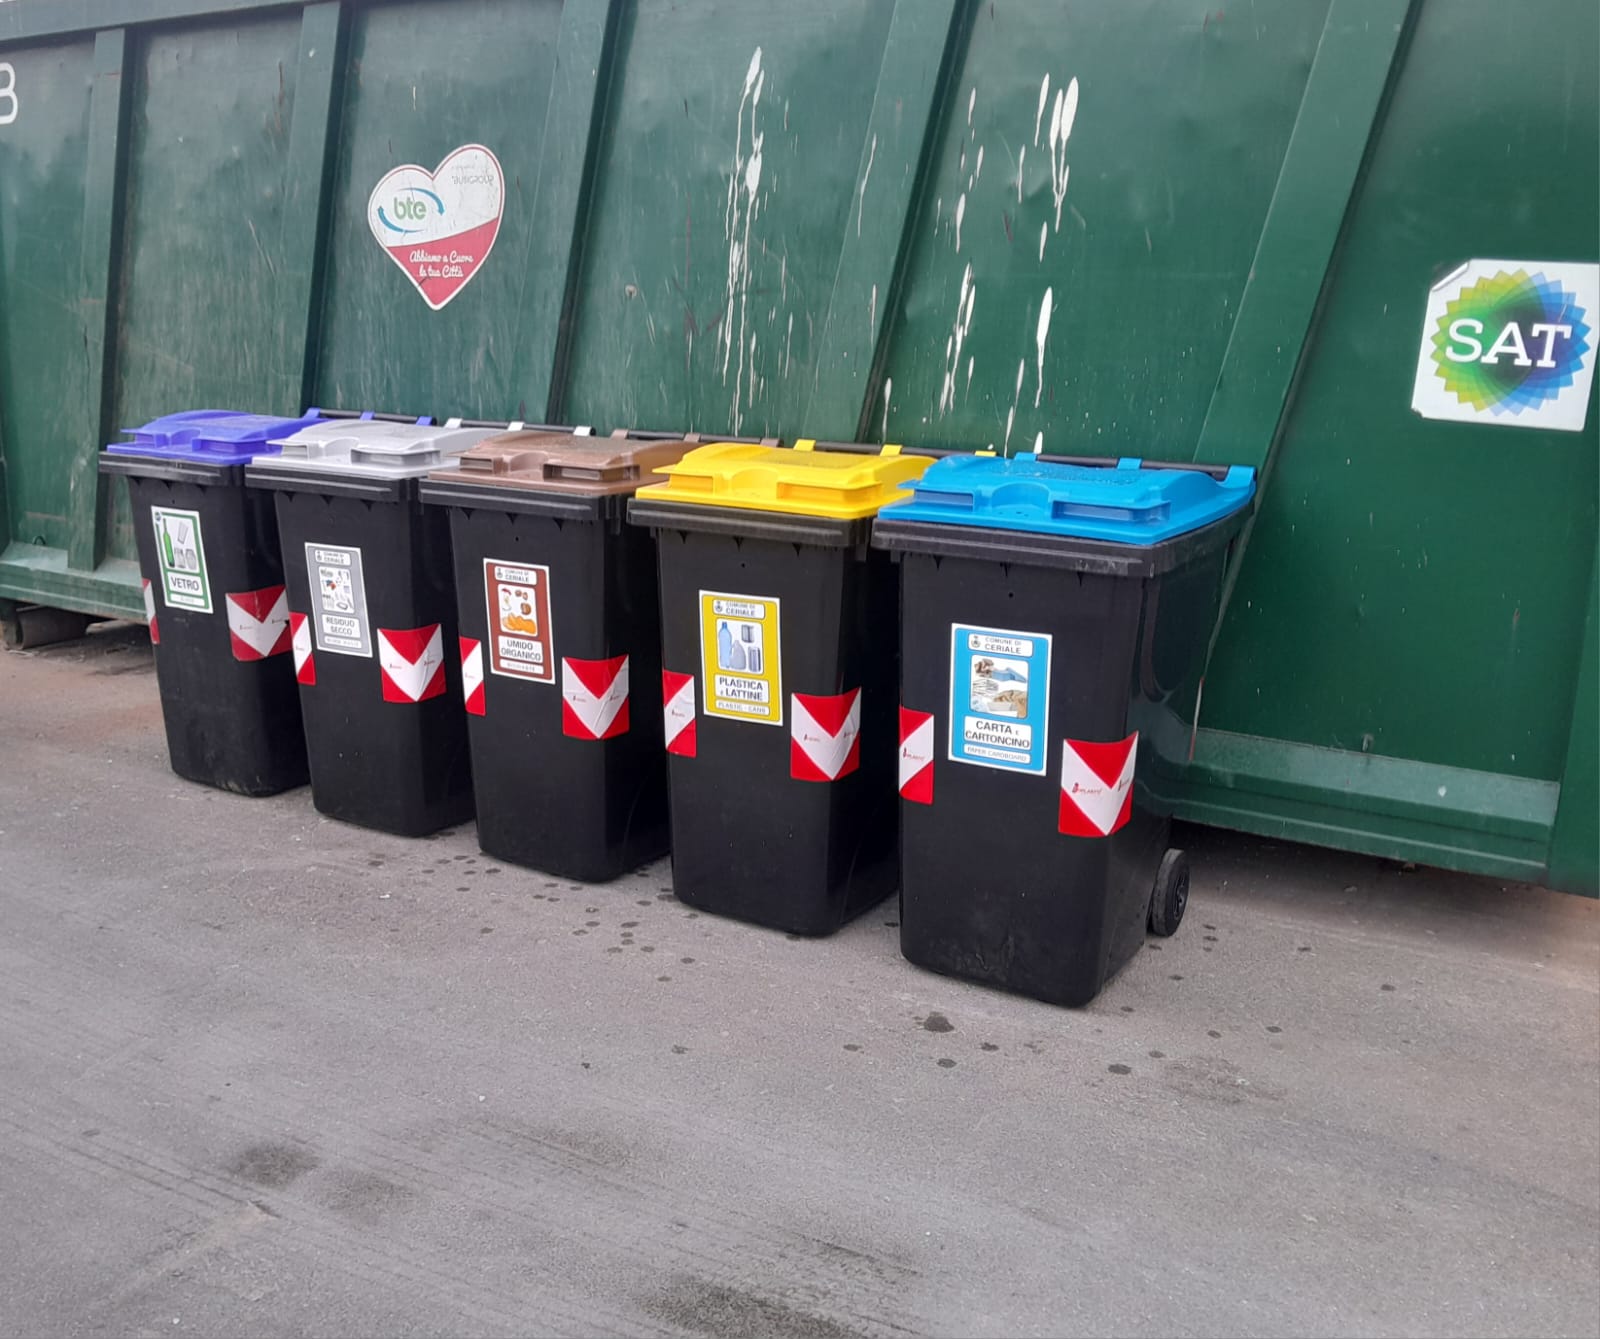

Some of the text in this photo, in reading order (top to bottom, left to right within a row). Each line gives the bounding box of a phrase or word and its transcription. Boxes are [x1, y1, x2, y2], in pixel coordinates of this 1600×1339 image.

[393, 197, 427, 220] bte
[409, 250, 474, 263] Abbiamo a Cuore
[419, 264, 464, 278] la tua Città
[1445, 318, 1573, 368] SAT
[171, 576, 199, 592] VETRO
[504, 574, 529, 583] CERIALE
[725, 607, 755, 617] CERIALE
[326, 616, 355, 628] RESIDUO
[330, 625, 353, 636] SECCO
[506, 639, 533, 651] UMIDO
[985, 636, 1022, 646] COMUNE DI
[500, 647, 541, 662] ORGANICO
[984, 643, 1021, 654] CERIALE
[719, 677, 763, 691] PLASTICA
[725, 688, 763, 702] LATTINE
[976, 720, 1013, 734] CARTA
[965, 730, 1030, 749] CARTONCINO
[967, 747, 1027, 762] PAPER CARDBOARD
